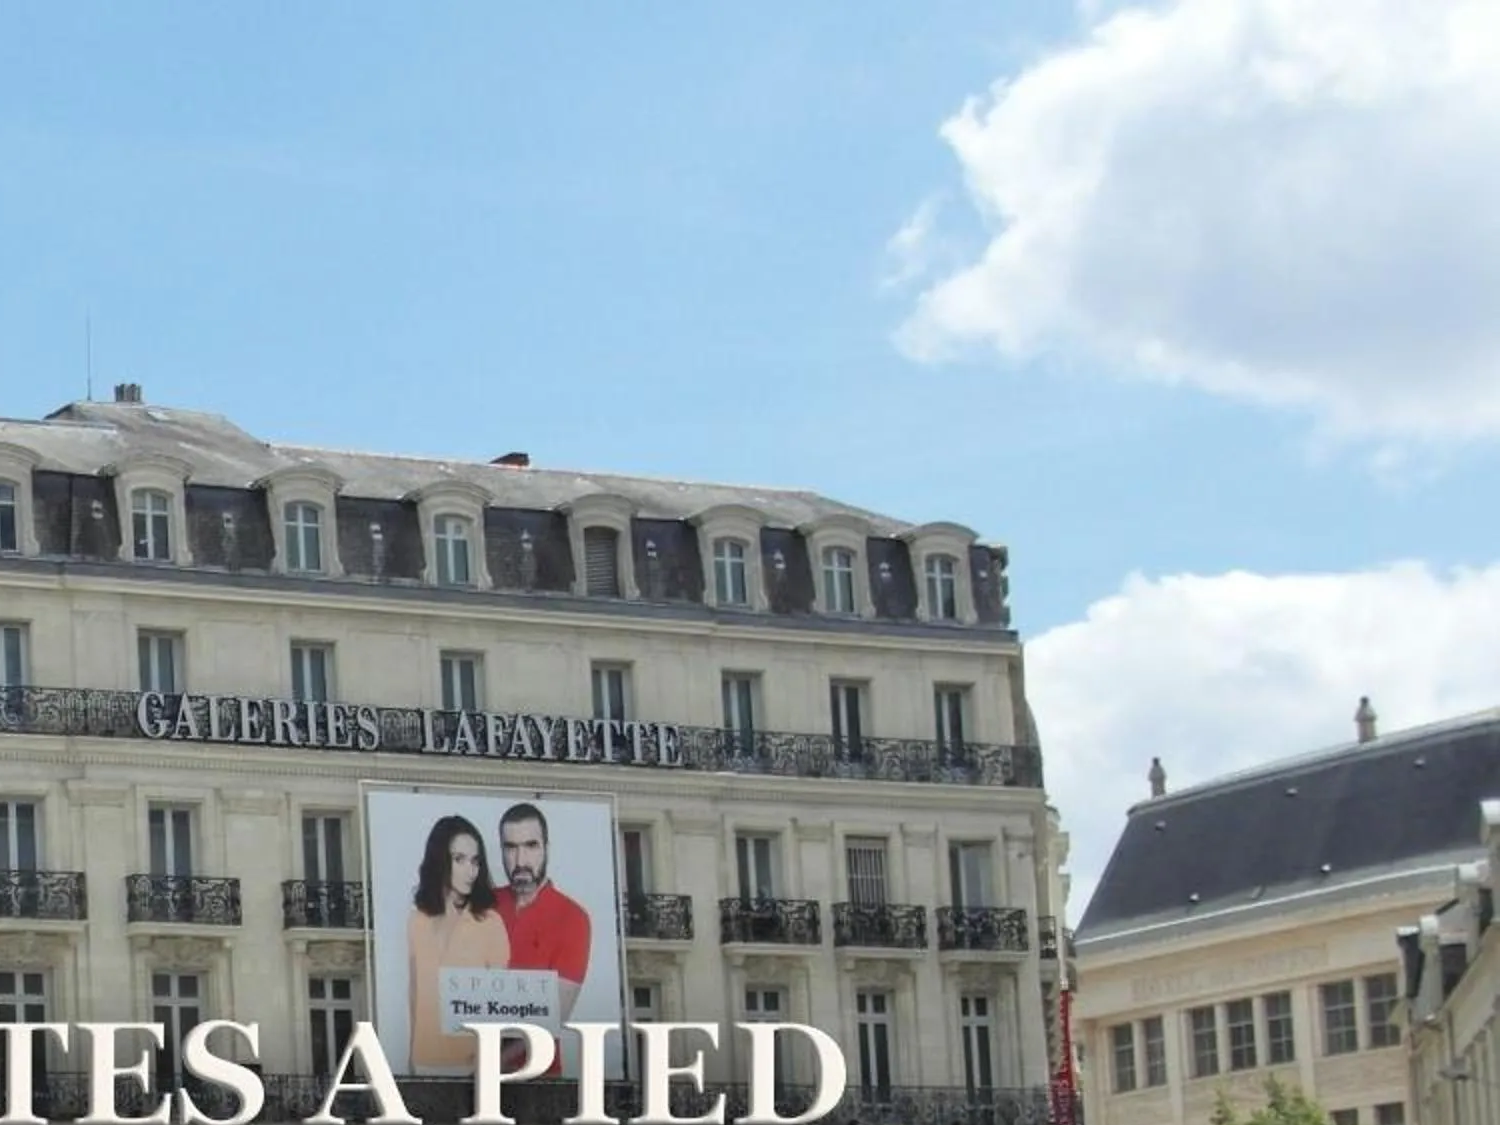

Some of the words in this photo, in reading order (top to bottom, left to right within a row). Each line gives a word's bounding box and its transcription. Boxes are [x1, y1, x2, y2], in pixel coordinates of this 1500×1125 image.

[137, 691, 381, 750] GALERIES
[421, 707, 683, 766] LAFAYETTE
[448, 975, 548, 995] SPORT
[450, 1000, 481, 1015] The
[487, 1000, 549, 1018] Kooples
